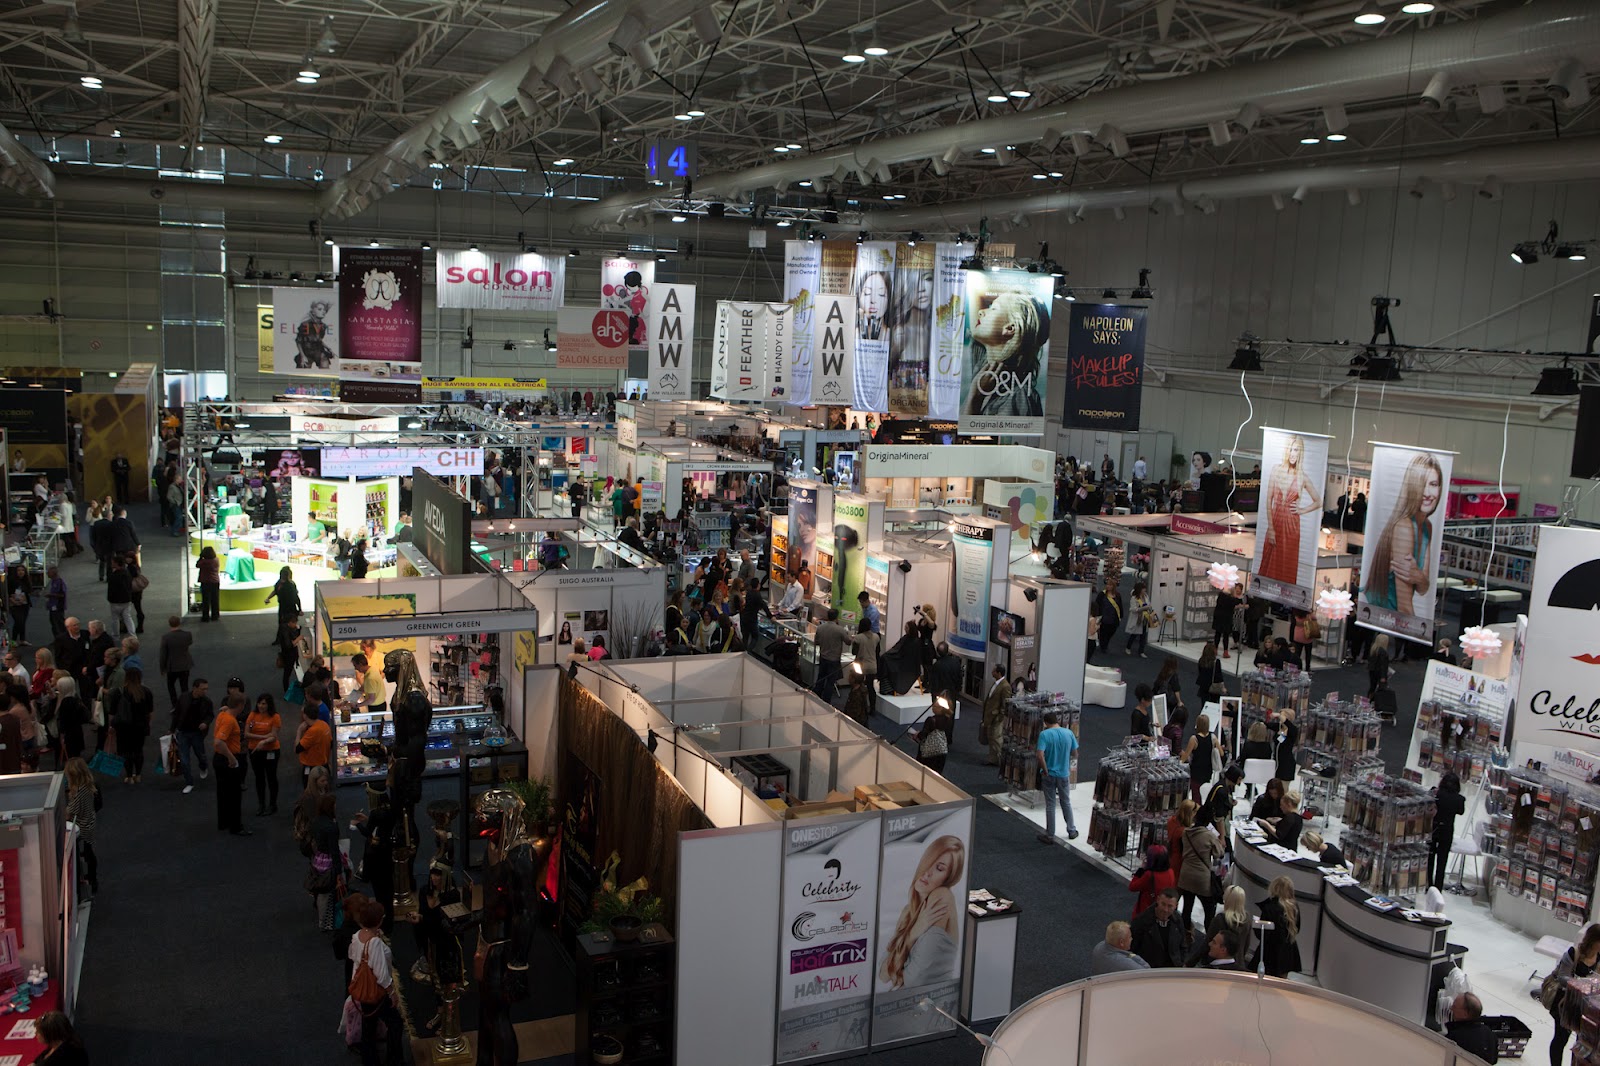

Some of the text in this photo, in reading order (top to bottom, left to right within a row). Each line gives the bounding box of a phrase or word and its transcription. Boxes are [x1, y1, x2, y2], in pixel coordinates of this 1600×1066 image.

[667, 146, 689, 176] 4
[604, 260, 638, 269] salon
[446, 262, 553, 287] salon
[482, 284, 552, 292] CONCEPTS
[353, 316, 410, 325] ANASTASIA
[597, 312, 622, 343] ahc
[1082, 316, 1133, 332] NAPOLEON
[740, 308, 753, 373] FEATHER
[774, 309, 785, 374] HANDY FOILS
[1093, 331, 1121, 345] SAYS:
[559, 355, 626, 365] SALON SELECT
[1071, 354, 1133, 376] MAKEUP
[891, 398, 927, 408] ORGANIC
[1078, 409, 1125, 418] napoleon
[930, 423, 958, 431] napoleo
[437, 450, 476, 467] CHI
[1228, 478, 1261, 486] napoleo
[424, 499, 446, 538] AVEDA
[406, 622, 453, 631] GREENWICH
[1554, 751, 1594, 772] HAIRTALK
[888, 816, 916, 831] TAPE
[791, 840, 814, 848] SHOP
[802, 880, 861, 899] Celebrity
[795, 974, 858, 999] HAIRTALK
